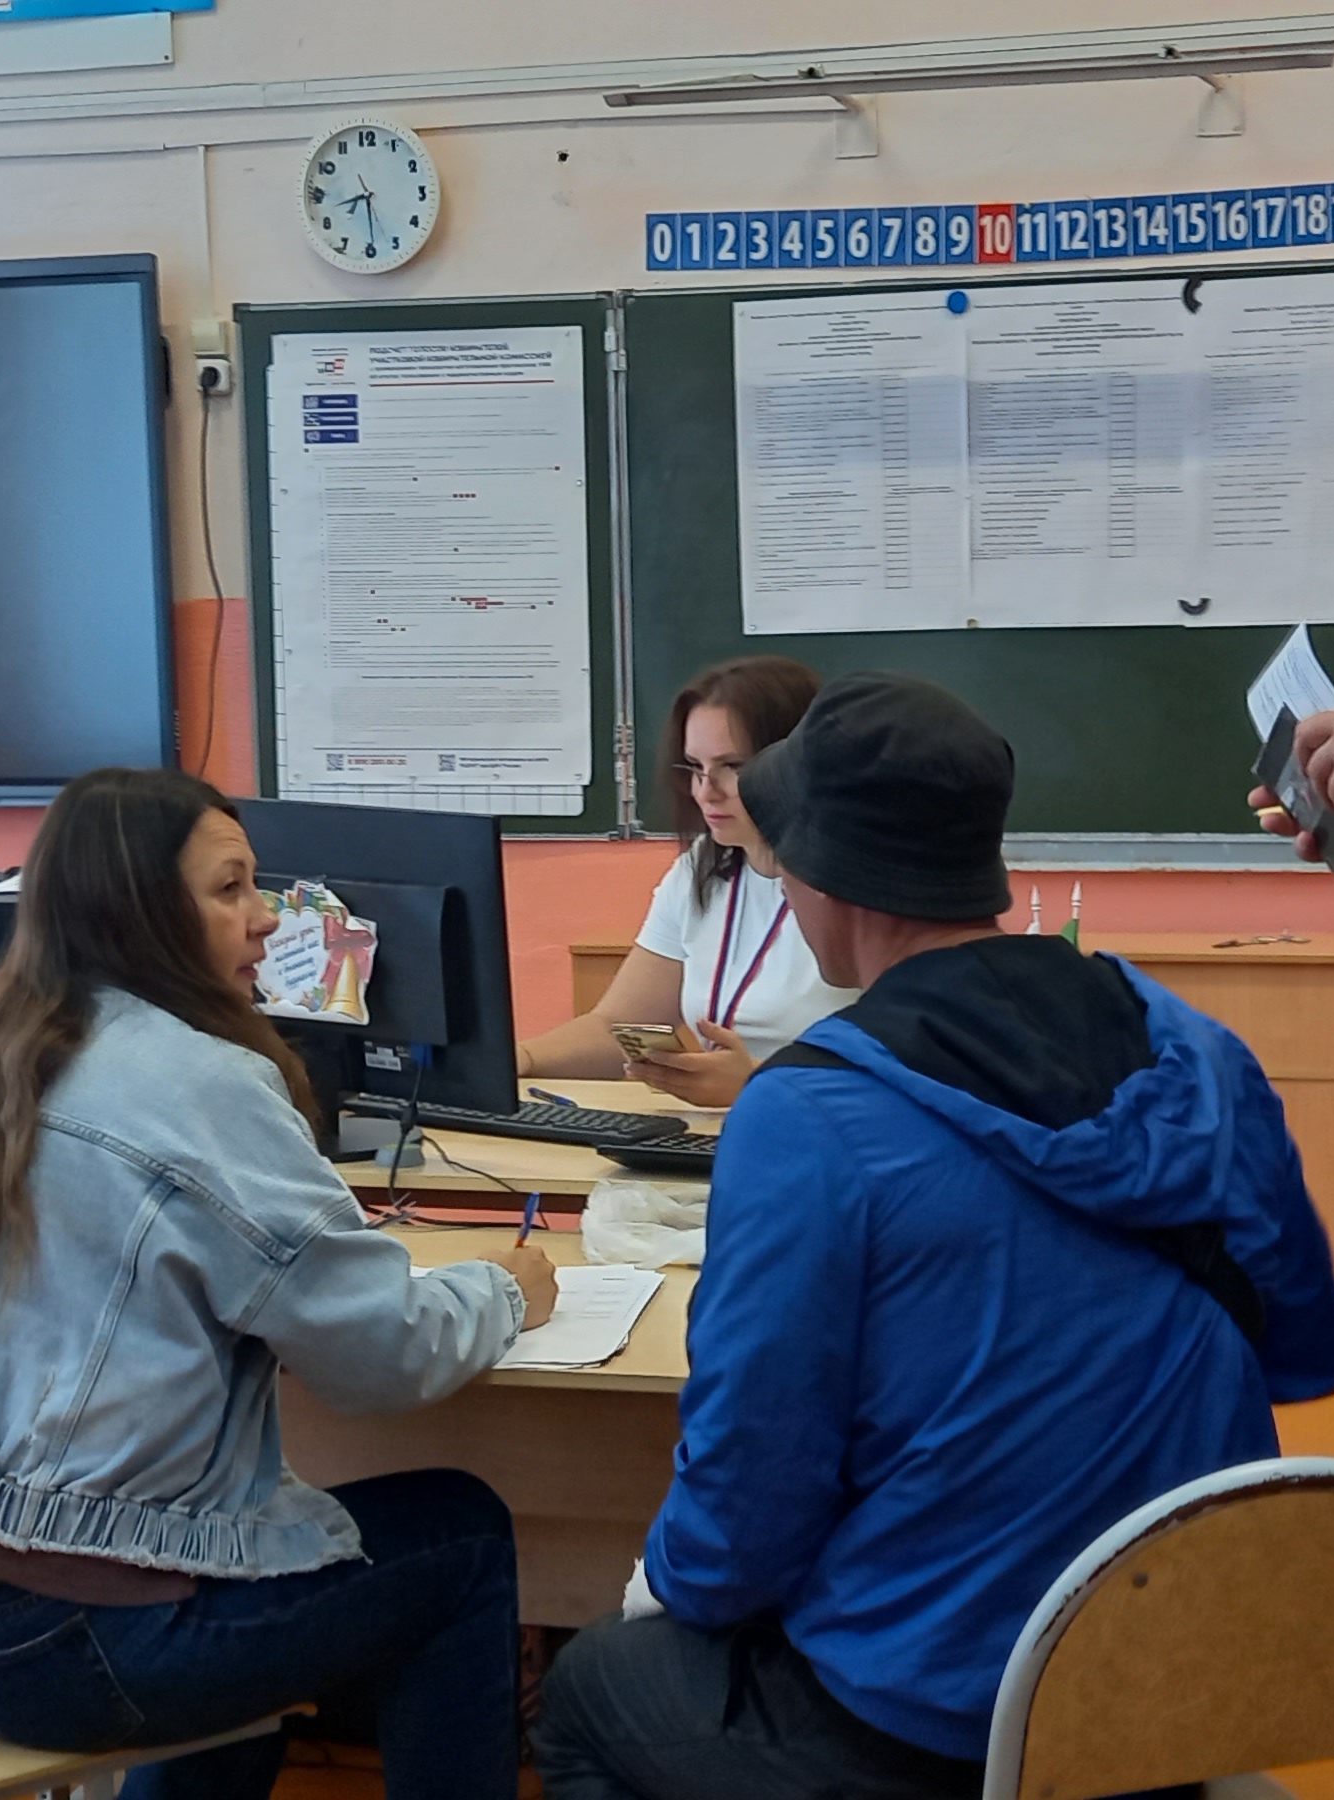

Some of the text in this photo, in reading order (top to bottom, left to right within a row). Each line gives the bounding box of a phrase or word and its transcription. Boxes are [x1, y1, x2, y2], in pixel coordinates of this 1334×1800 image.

[358, 130, 376, 147] 12
[338, 141, 348, 155] 11
[318, 160, 336, 175] 10
[408, 159, 417, 173] 2
[418, 185, 427, 202] 3
[322, 216, 332, 230] 8
[652, 223, 673, 263] 0
[685, 223, 701, 262] 1
[716, 221, 737, 261] 2
[748, 221, 768, 261] 3
[780, 220, 804, 260] 4
[815, 219, 835, 259] 5
[848, 218, 868, 259] 6
[881, 217, 903, 258] 7
[915, 216, 937, 257] 8
[948, 215, 970, 256] 9
[979, 214, 1012, 255] 10
[1017, 212, 1048, 253] 11
[1056, 210, 1089, 251] 12
[1094, 207, 1127, 249] 13
[1133, 205, 1169, 247] 14
[1173, 202, 1207, 244] 15
[1212, 200, 1249, 241] 16
[1252, 197, 1288, 239] 17
[1292, 194, 1328, 236] 18
[365, 242, 377, 259] 6
